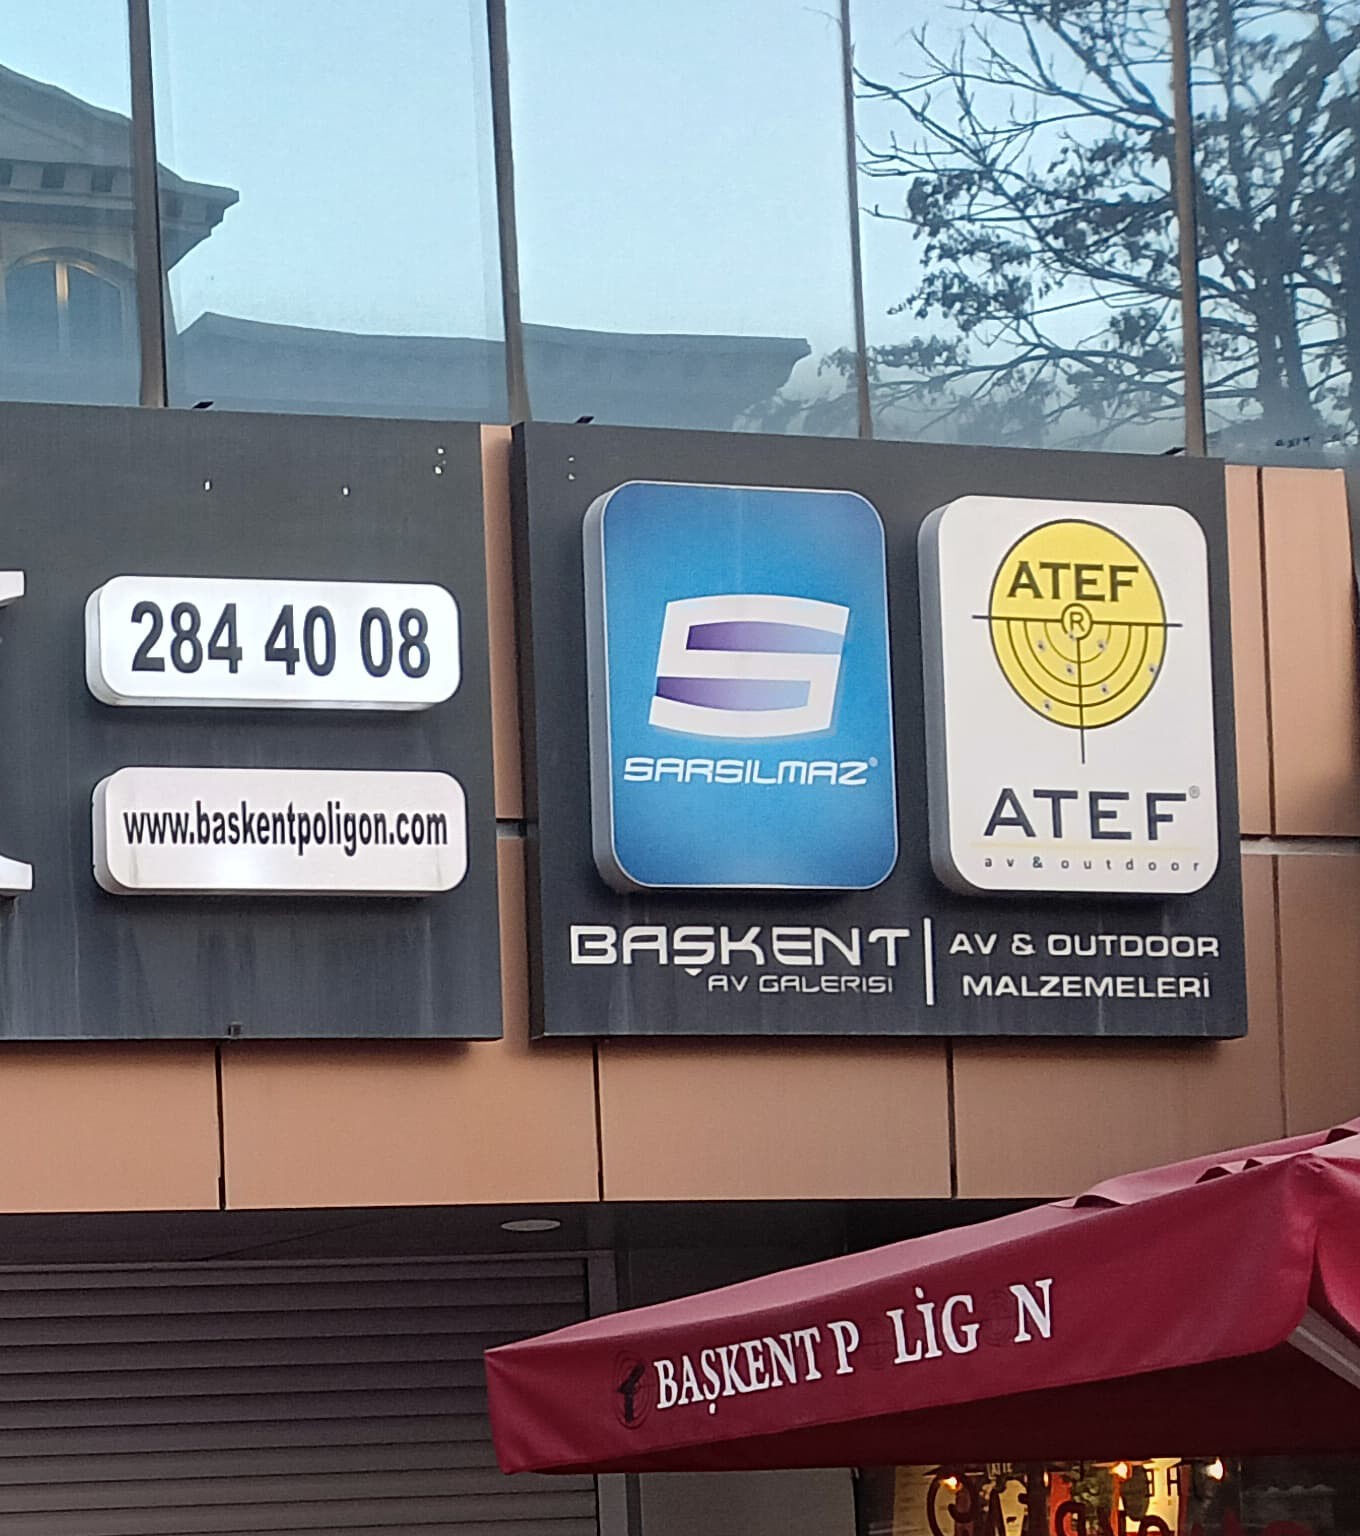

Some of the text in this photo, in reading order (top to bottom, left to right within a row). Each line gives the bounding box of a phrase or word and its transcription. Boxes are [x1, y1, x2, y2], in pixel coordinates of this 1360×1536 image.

[1007, 560, 1139, 603] ATEF
[130, 600, 431, 678] 284 40 08
[623, 756, 869, 785] SARSILMAZ
[123, 800, 449, 856] www.baskentpoligon.com
[570, 924, 911, 977] BAŞKENT
[949, 932, 1220, 958] AV & OUTDOOR
[707, 974, 750, 992] AV
[962, 972, 1211, 999] MALZEMELERİ
[653, 1327, 821, 1414] BAŞKENT
